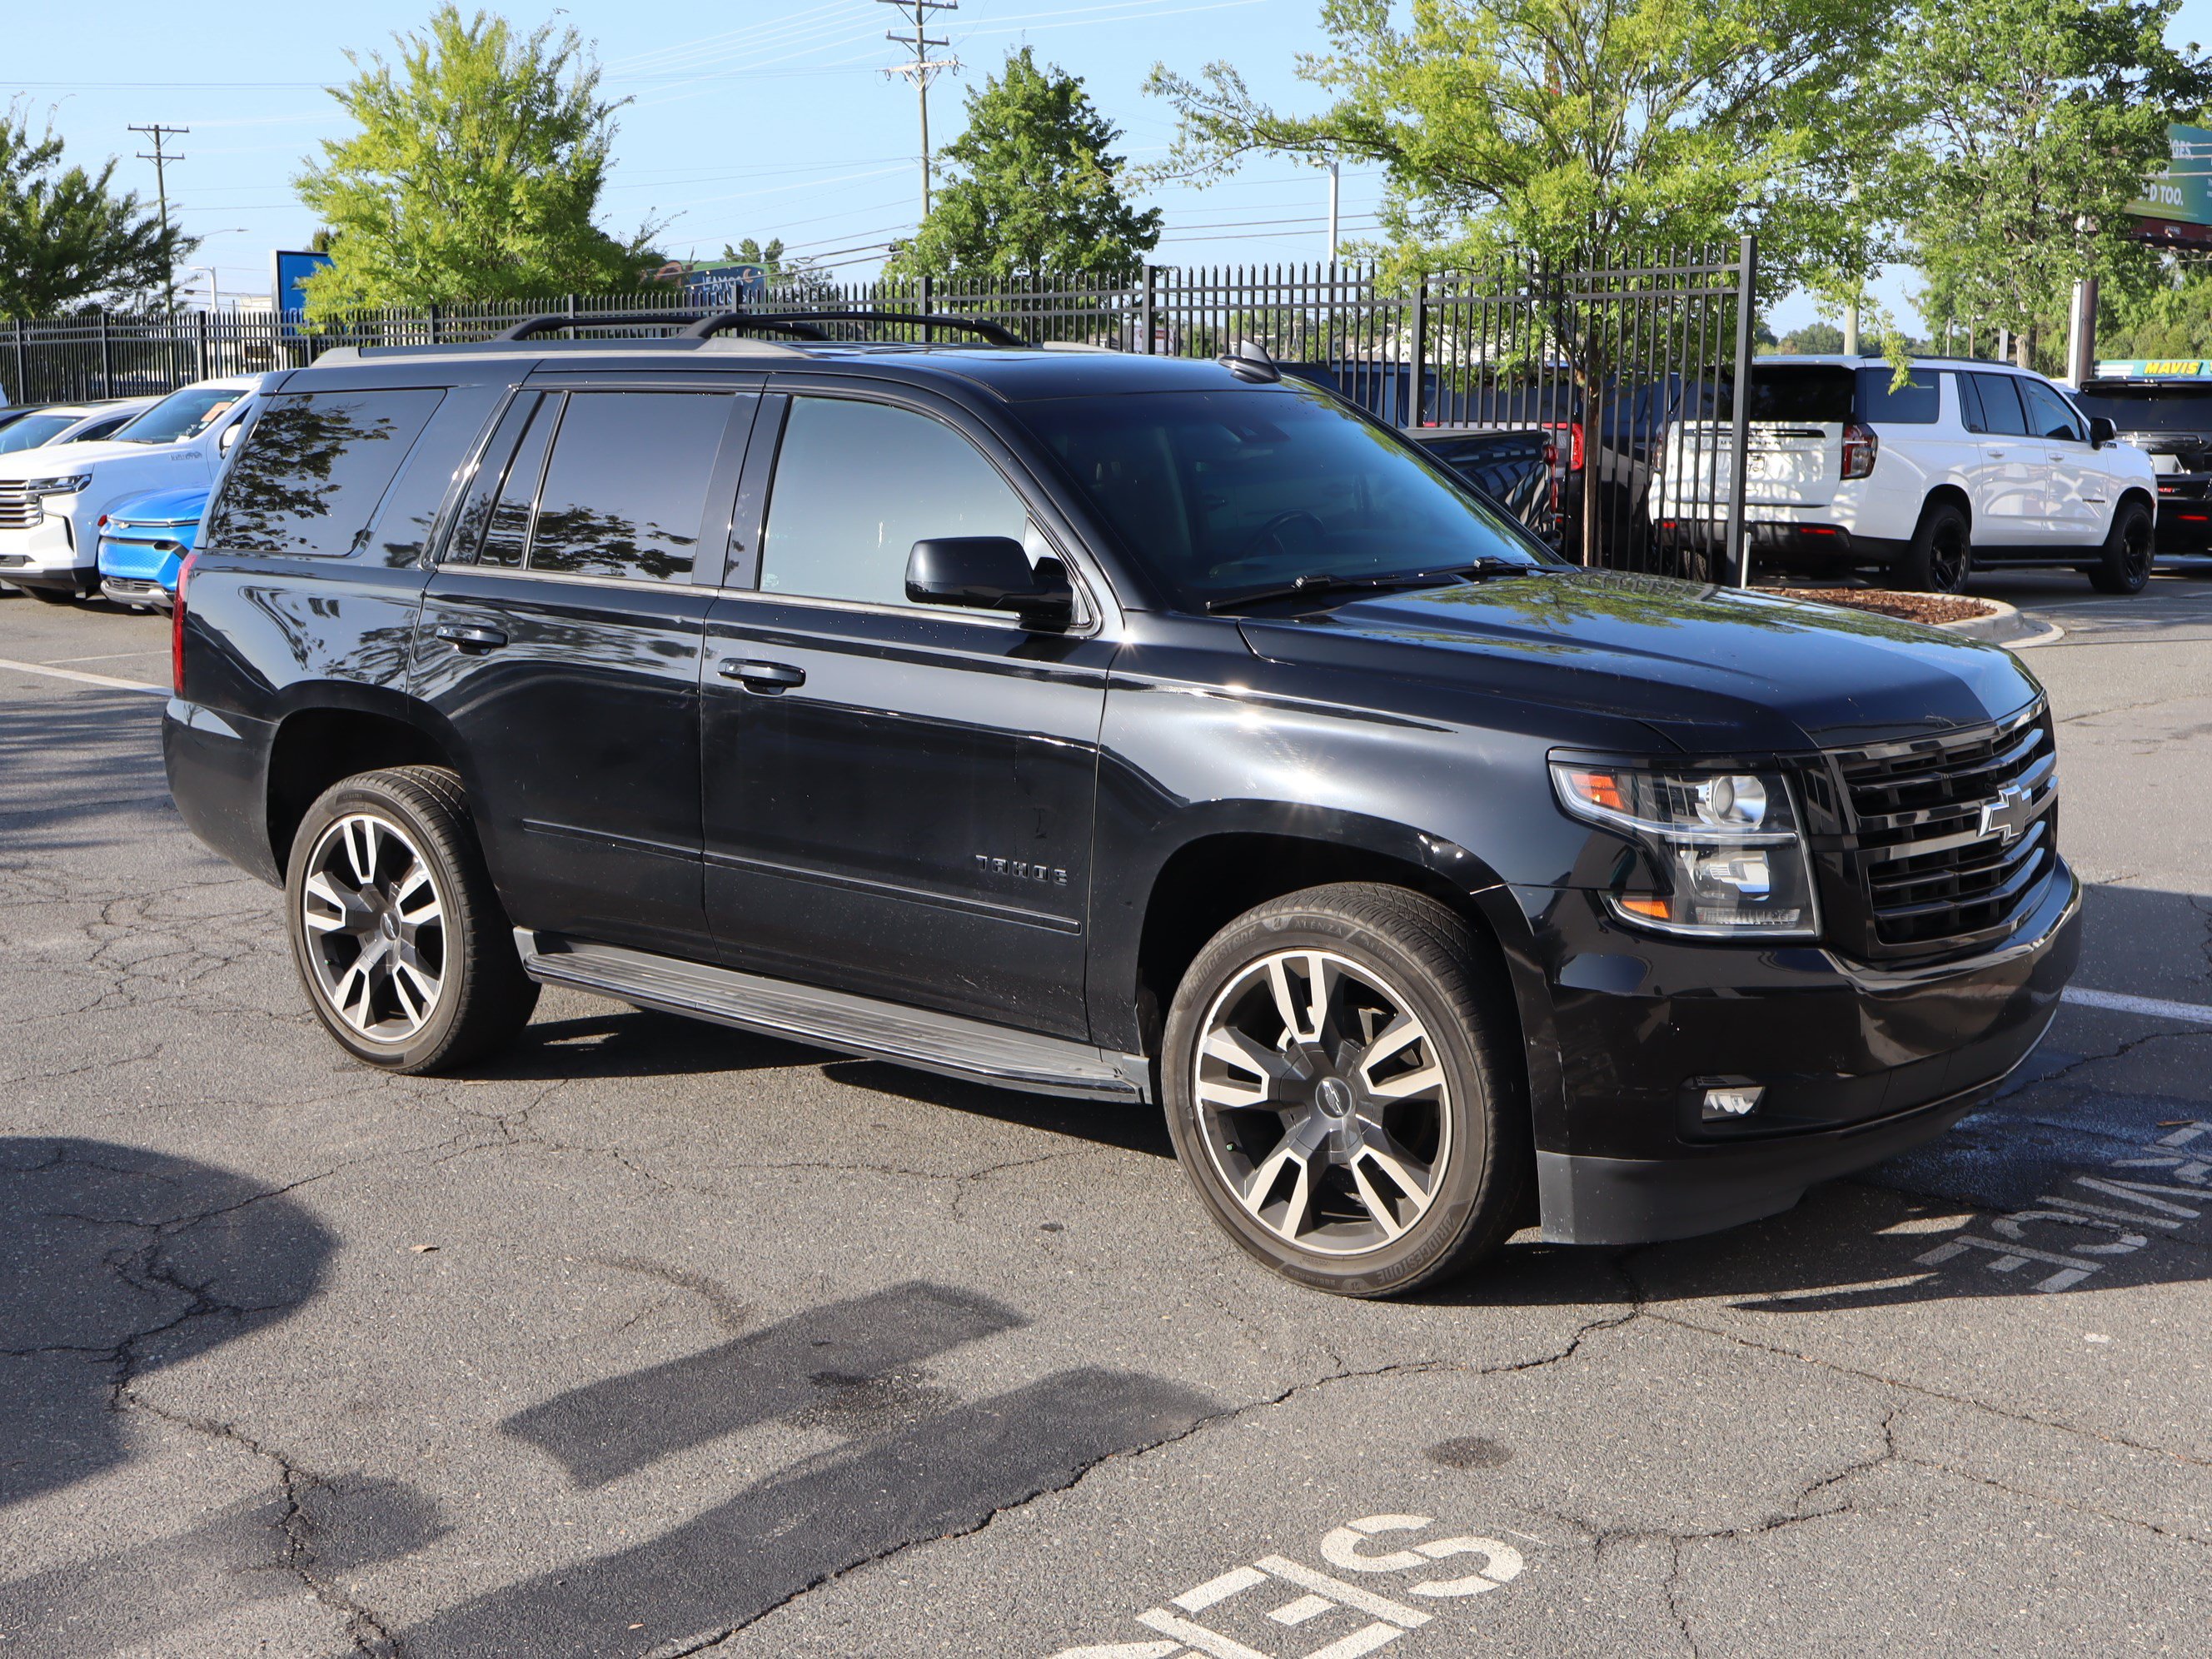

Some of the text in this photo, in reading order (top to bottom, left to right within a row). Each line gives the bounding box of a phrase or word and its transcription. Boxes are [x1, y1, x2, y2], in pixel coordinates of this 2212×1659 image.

[2169, 139, 2194, 161] GES.
[2160, 185, 2184, 207] TOO.
[2143, 361, 2200, 375] MAVIS
[975, 854, 1068, 886] TAHOE
[1293, 919, 1343, 936] ALENZA
[1185, 924, 1258, 1003] BRIDGESTONE
[1376, 1213, 1456, 1284] BRIDGESTONE
